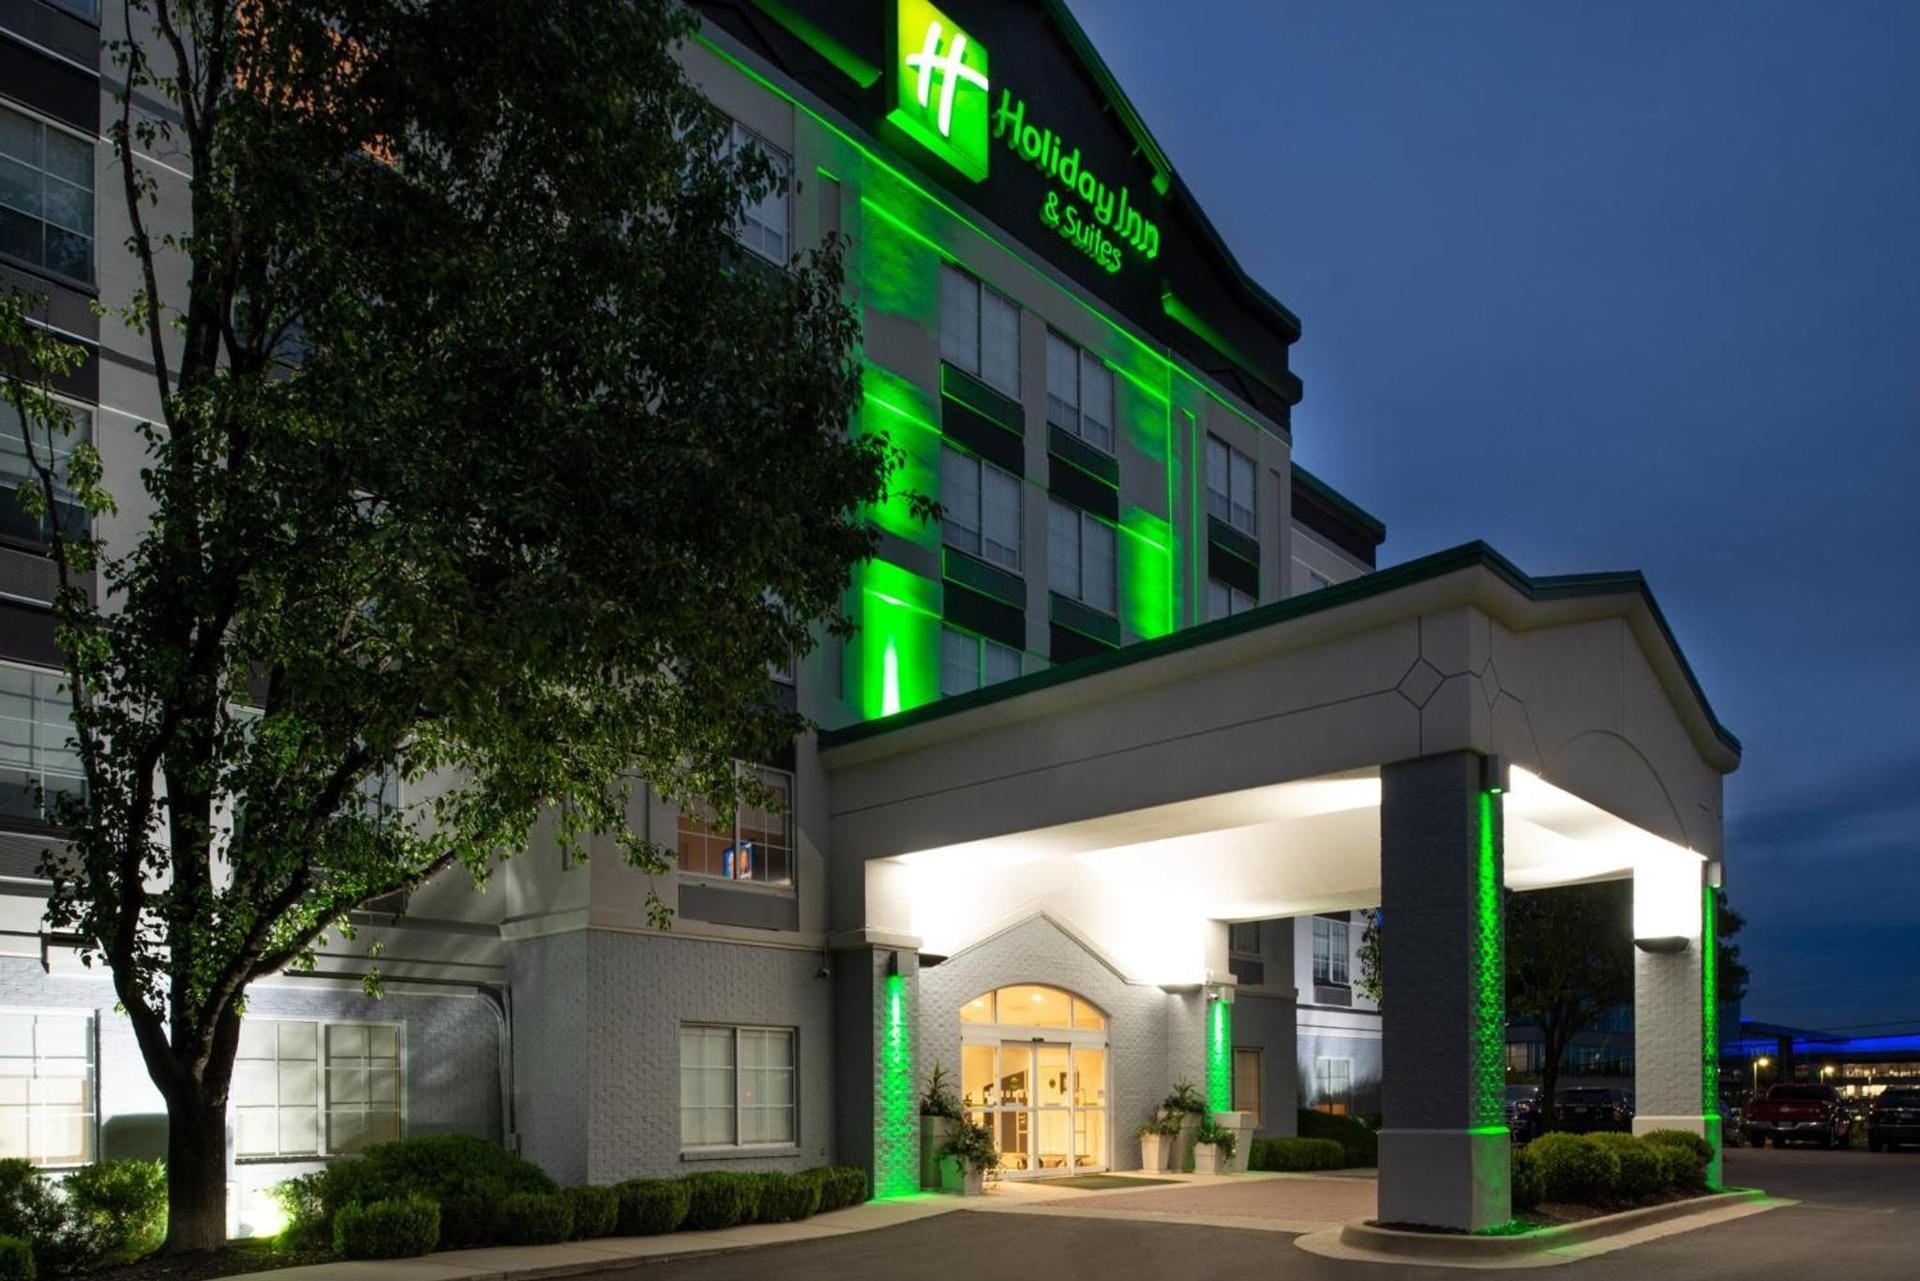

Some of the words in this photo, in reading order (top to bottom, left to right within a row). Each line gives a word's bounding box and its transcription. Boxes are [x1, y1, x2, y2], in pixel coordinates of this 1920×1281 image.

[992, 87, 1114, 225] Holiday
[1113, 186, 1160, 259] Inn
[1041, 191, 1060, 227] &
[1060, 205, 1122, 273] Suites
